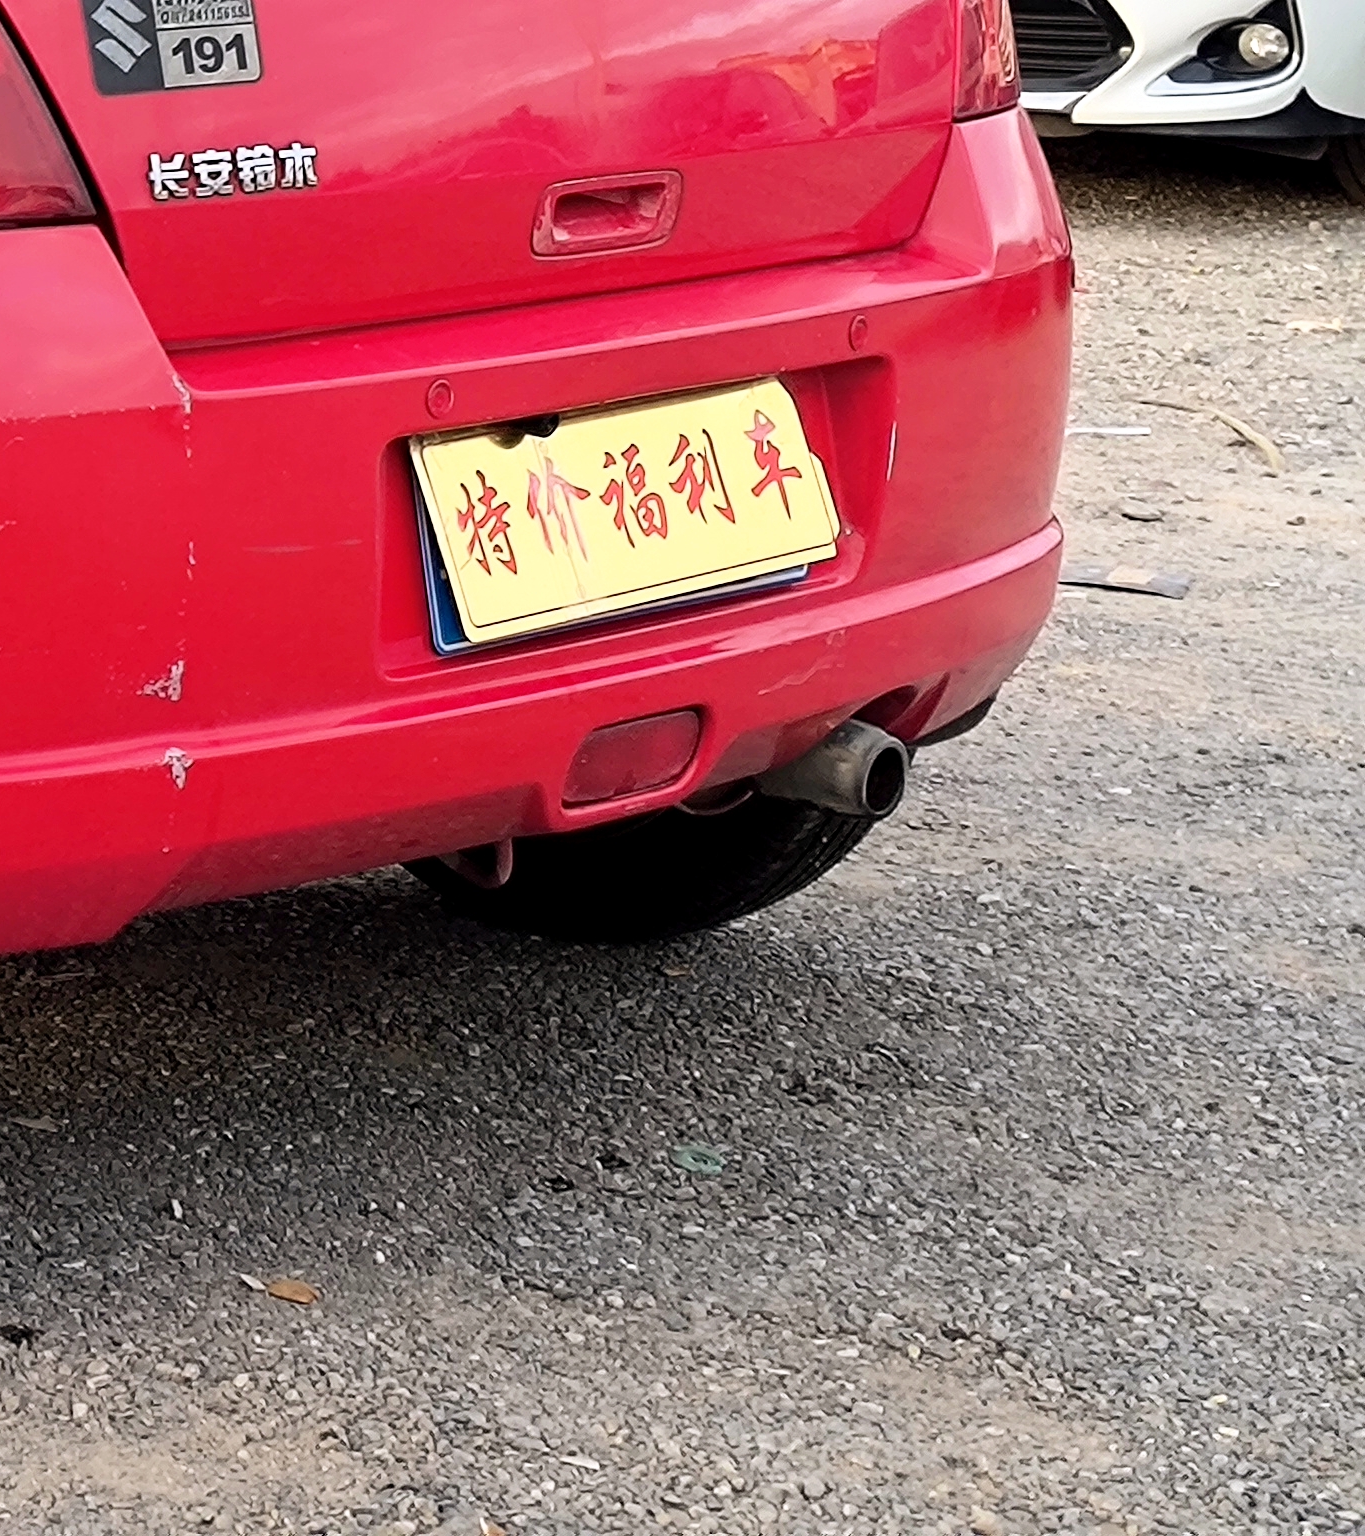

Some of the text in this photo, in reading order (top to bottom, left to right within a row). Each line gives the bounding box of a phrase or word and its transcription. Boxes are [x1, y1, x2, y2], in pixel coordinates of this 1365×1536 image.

[171, 32, 249, 76] 191
[148, 141, 320, 201] 长安铃木
[457, 408, 803, 577] 特价福利车
